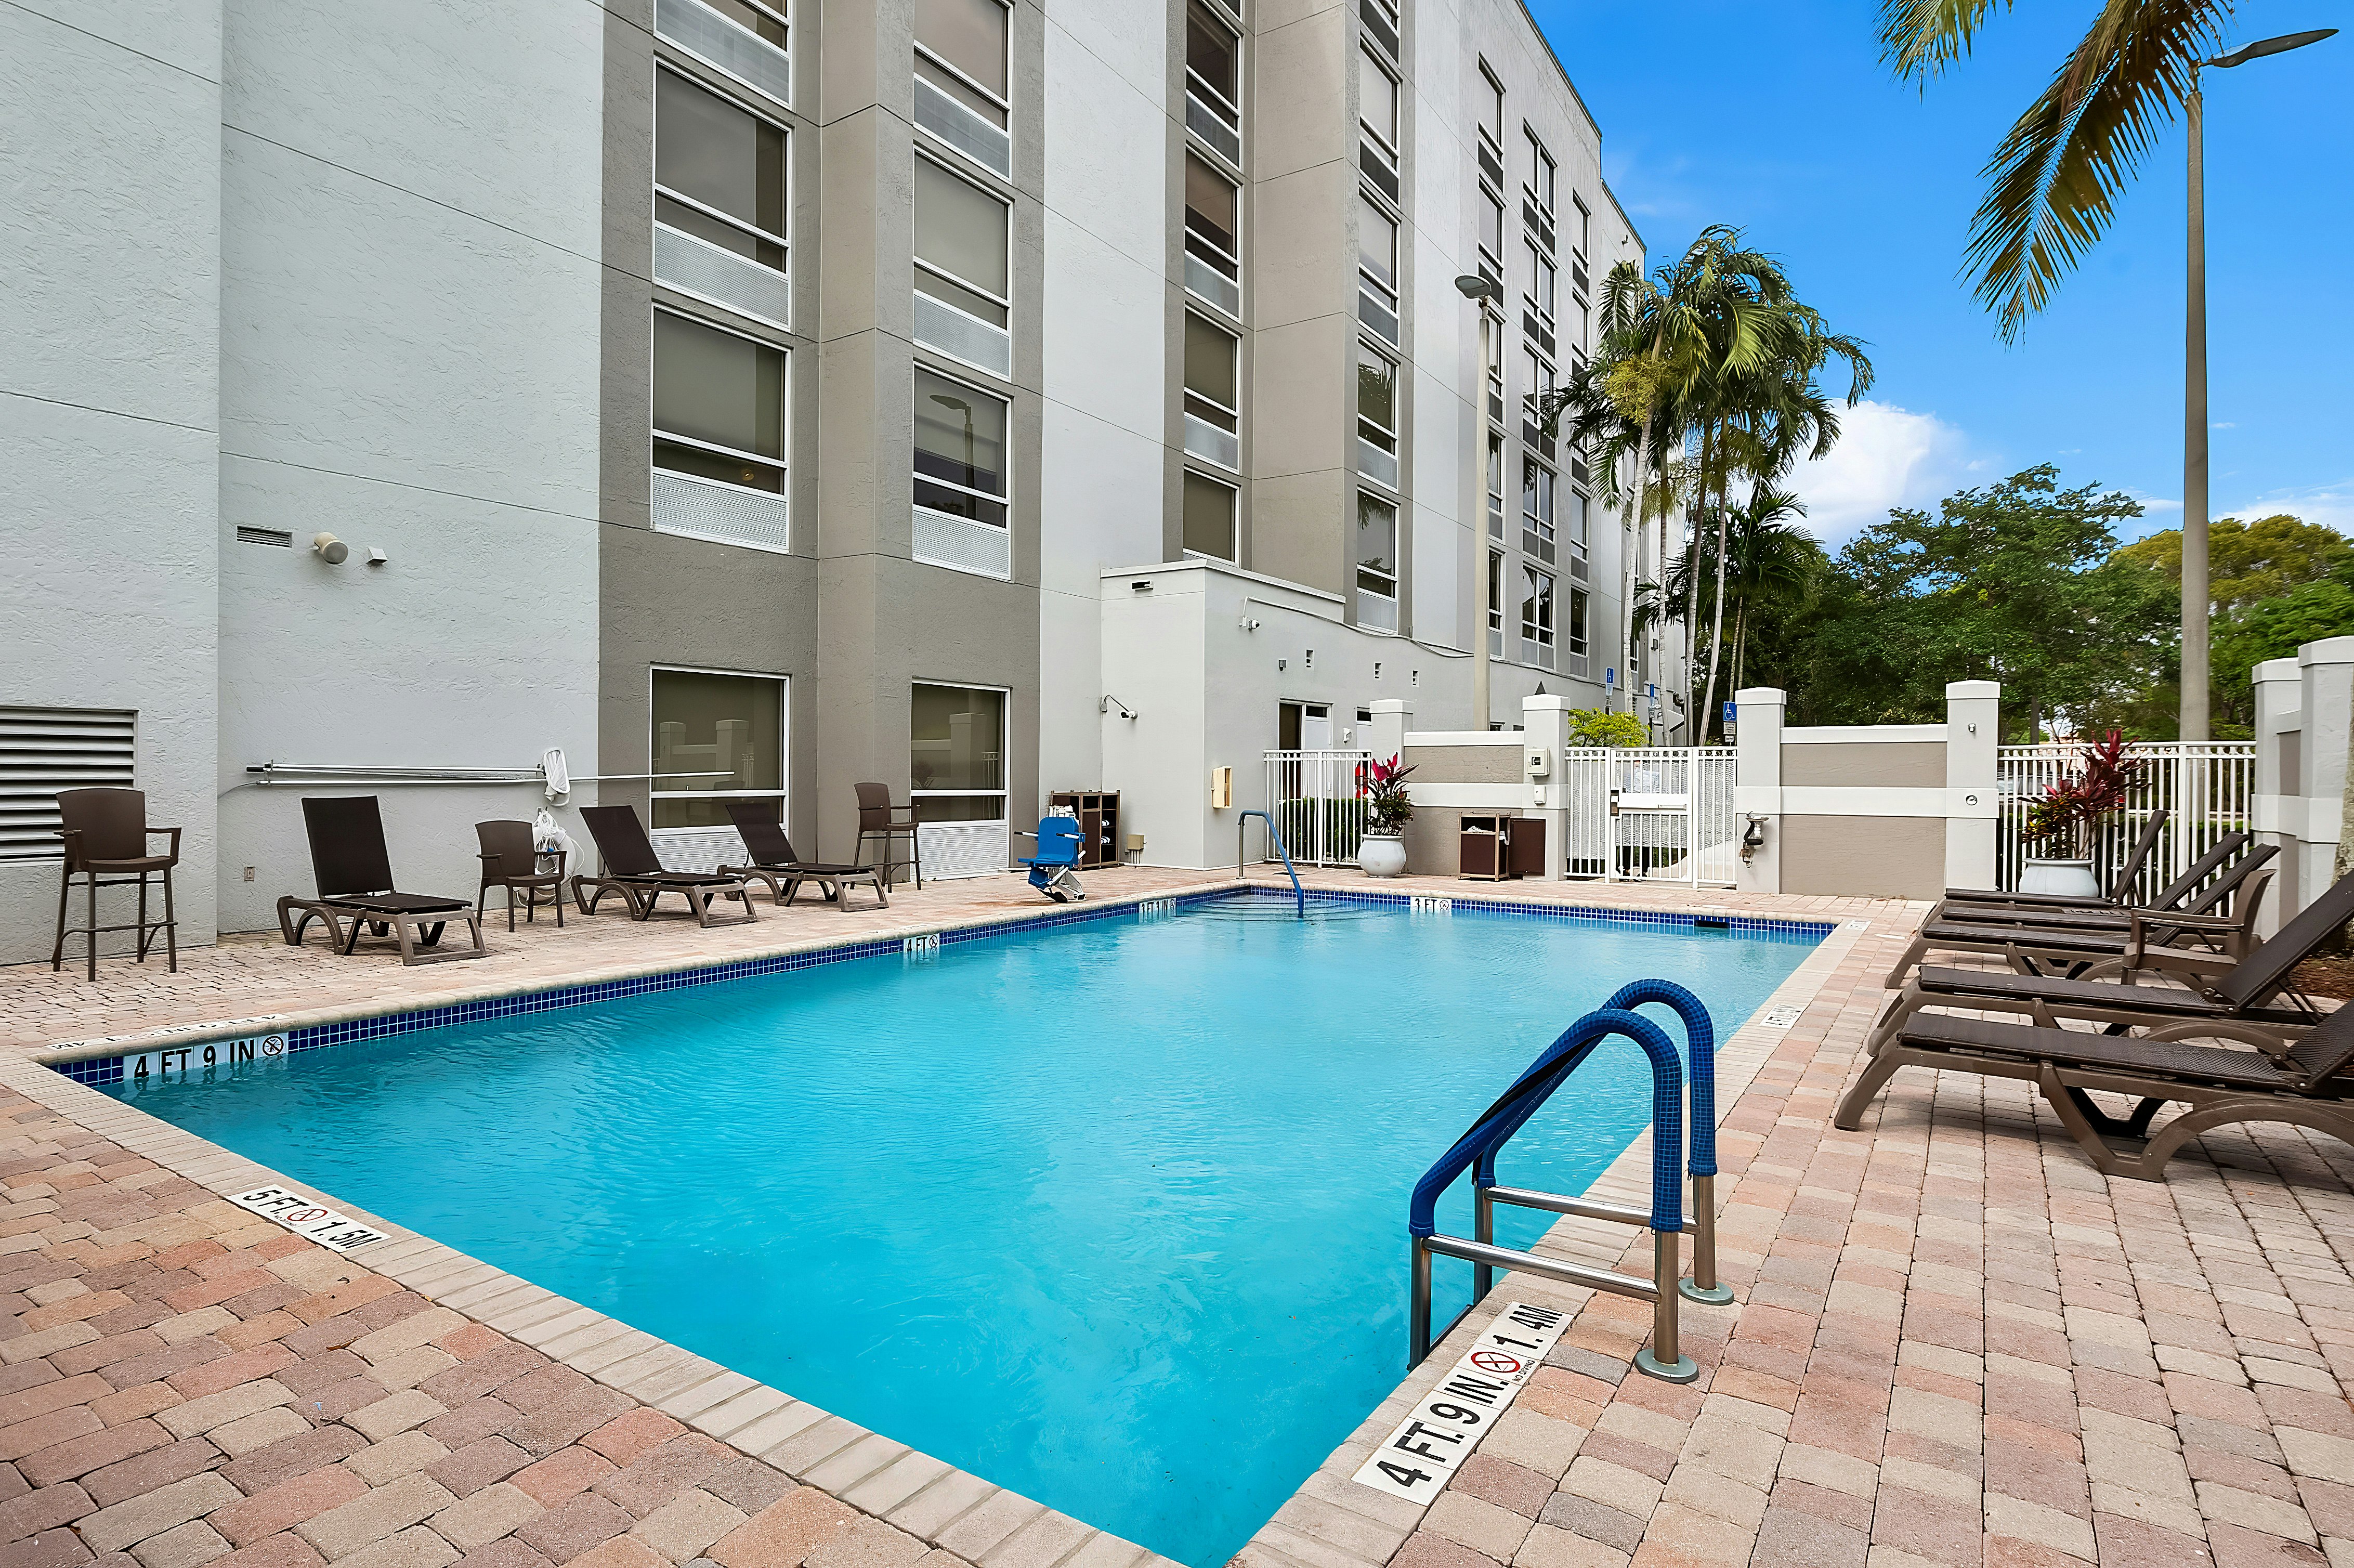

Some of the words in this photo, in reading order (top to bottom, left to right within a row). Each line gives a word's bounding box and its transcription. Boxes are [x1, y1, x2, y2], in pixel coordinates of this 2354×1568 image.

[916, 937, 927, 952] FT
[134, 1055, 149, 1078] 4
[161, 1048, 192, 1074] FT
[203, 1045, 216, 1068] 9
[230, 1039, 254, 1063] IN
[243, 1190, 283, 1201] 5
[1376, 1460, 1432, 1487] 4
[1429, 1403, 1480, 1425] 9
